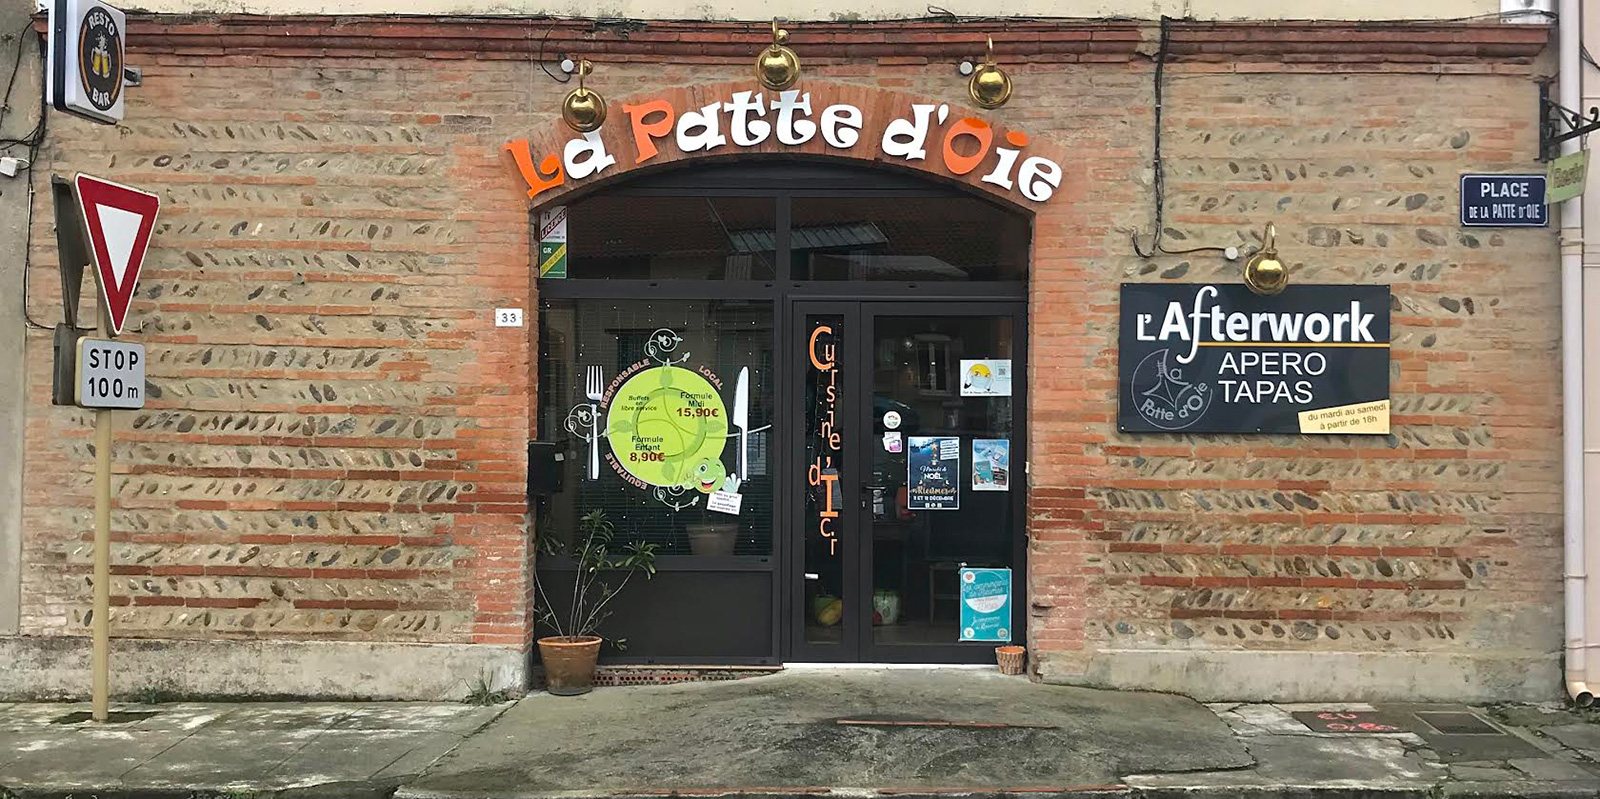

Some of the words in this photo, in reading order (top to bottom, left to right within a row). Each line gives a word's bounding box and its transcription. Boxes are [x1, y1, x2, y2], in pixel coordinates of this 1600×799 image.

[88, 12, 115, 36] RESTO
[92, 87, 111, 106] BAR
[502, 126, 616, 200] La
[622, 89, 864, 164] Patte
[881, 102, 1063, 203] d'Oie
[1480, 182, 1530, 198] PLACE
[1469, 206, 1478, 219] DE
[1480, 206, 1489, 219] LA
[1492, 204, 1516, 219] PATTE
[1518, 204, 1540, 219] D'OIE
[541, 209, 567, 239] LICENCE
[501, 312, 517, 323] 33
[1136, 285, 1376, 365] L'Afterwork
[89, 348, 139, 371] STOP
[1218, 351, 1327, 376] APERO
[88, 376, 123, 398] 100
[127, 386, 138, 399] m
[600, 358, 651, 409] RESPONSABLE
[698, 365, 724, 390] LOCAL
[680, 392, 713, 400] Formule
[1140, 397, 1175, 421] Patte
[1178, 382, 1208, 419] d'Oie
[1217, 380, 1314, 404] TAPAS
[676, 407, 719, 419] 15,90€
[687, 400, 705, 408] Midi
[1307, 413, 1319, 421] du
[1320, 410, 1343, 419] mardi
[1357, 403, 1387, 413] samedi
[1327, 420, 1348, 430] partir
[1349, 418, 1360, 426] de
[1362, 415, 1378, 424] 18h
[631, 435, 664, 443] Formule
[629, 451, 666, 463] 8,90€
[604, 452, 648, 491] EQUITABLE
[923, 472, 943, 480] NOËL
